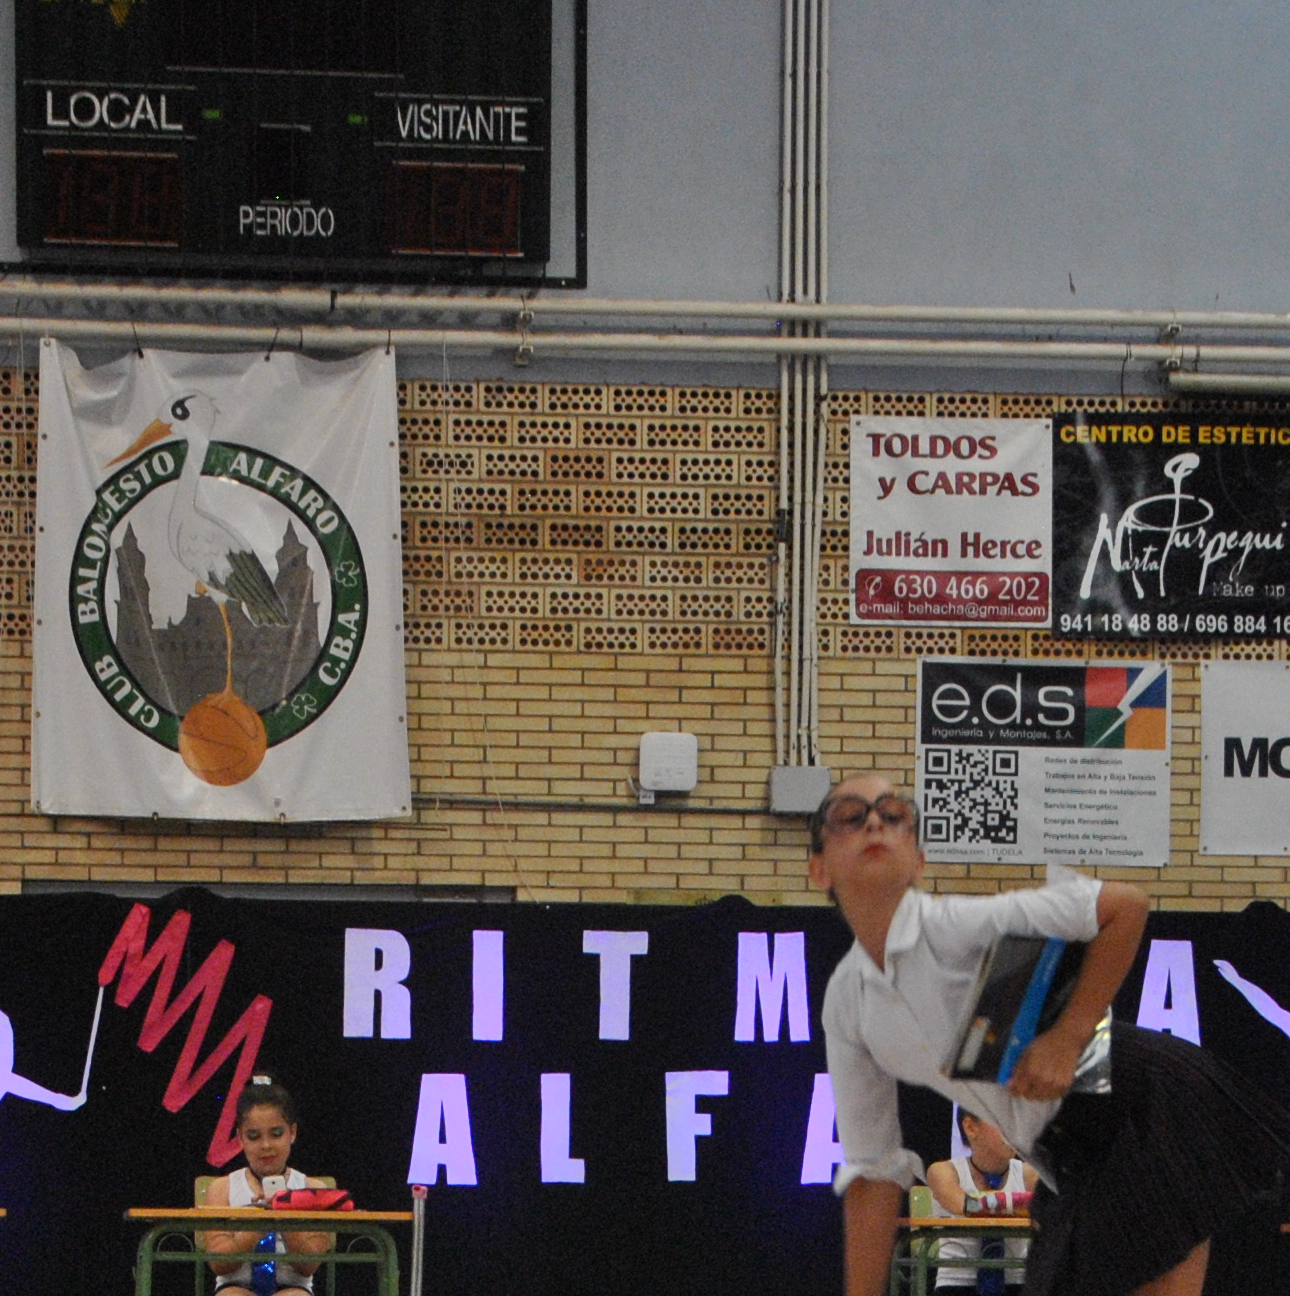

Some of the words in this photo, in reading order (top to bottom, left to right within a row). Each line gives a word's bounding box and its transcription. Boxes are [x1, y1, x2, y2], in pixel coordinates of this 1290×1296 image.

[45, 90, 183, 131] LOCAL
[397, 102, 528, 143] VISITANTE
[239, 205, 334, 237] PERIODO
[866, 431, 997, 461] TOLDOS
[1060, 425, 1154, 444] CENTRO
[1162, 425, 1191, 444] DE
[229, 451, 340, 536] ALFARO
[877, 475, 896, 499] y
[906, 470, 1040, 497] CARPAS
[862, 529, 949, 559] Julián
[960, 532, 1042, 560] Herce
[894, 575, 937, 599] 630
[945, 576, 989, 600] 466
[997, 577, 1040, 601] 202
[1212, 582, 1255, 598] Make
[1264, 584, 1286, 600] up
[859, 602, 904, 614] e-mail:
[908, 602, 1046, 618] behacha@gmail.com
[1060, 613, 1093, 633] 941
[1100, 613, 1123, 633] 18
[1128, 613, 1151, 633] 48
[1156, 614, 1179, 633] 88
[1195, 615, 1228, 633] 696
[1233, 615, 1267, 634] 884
[317, 602, 362, 687] C.B.A.
[92, 654, 161, 729] CLUB
[931, 671, 1076, 727] e.d.s
[931, 726, 984, 739] Ingeniería
[1087, 772, 1102, 780] Alta
[1109, 773, 1126, 782] Baja
[1043, 832, 1080, 841] Proyectos
[1081, 833, 1091, 841] de
[1088, 848, 1103, 856] Alta
